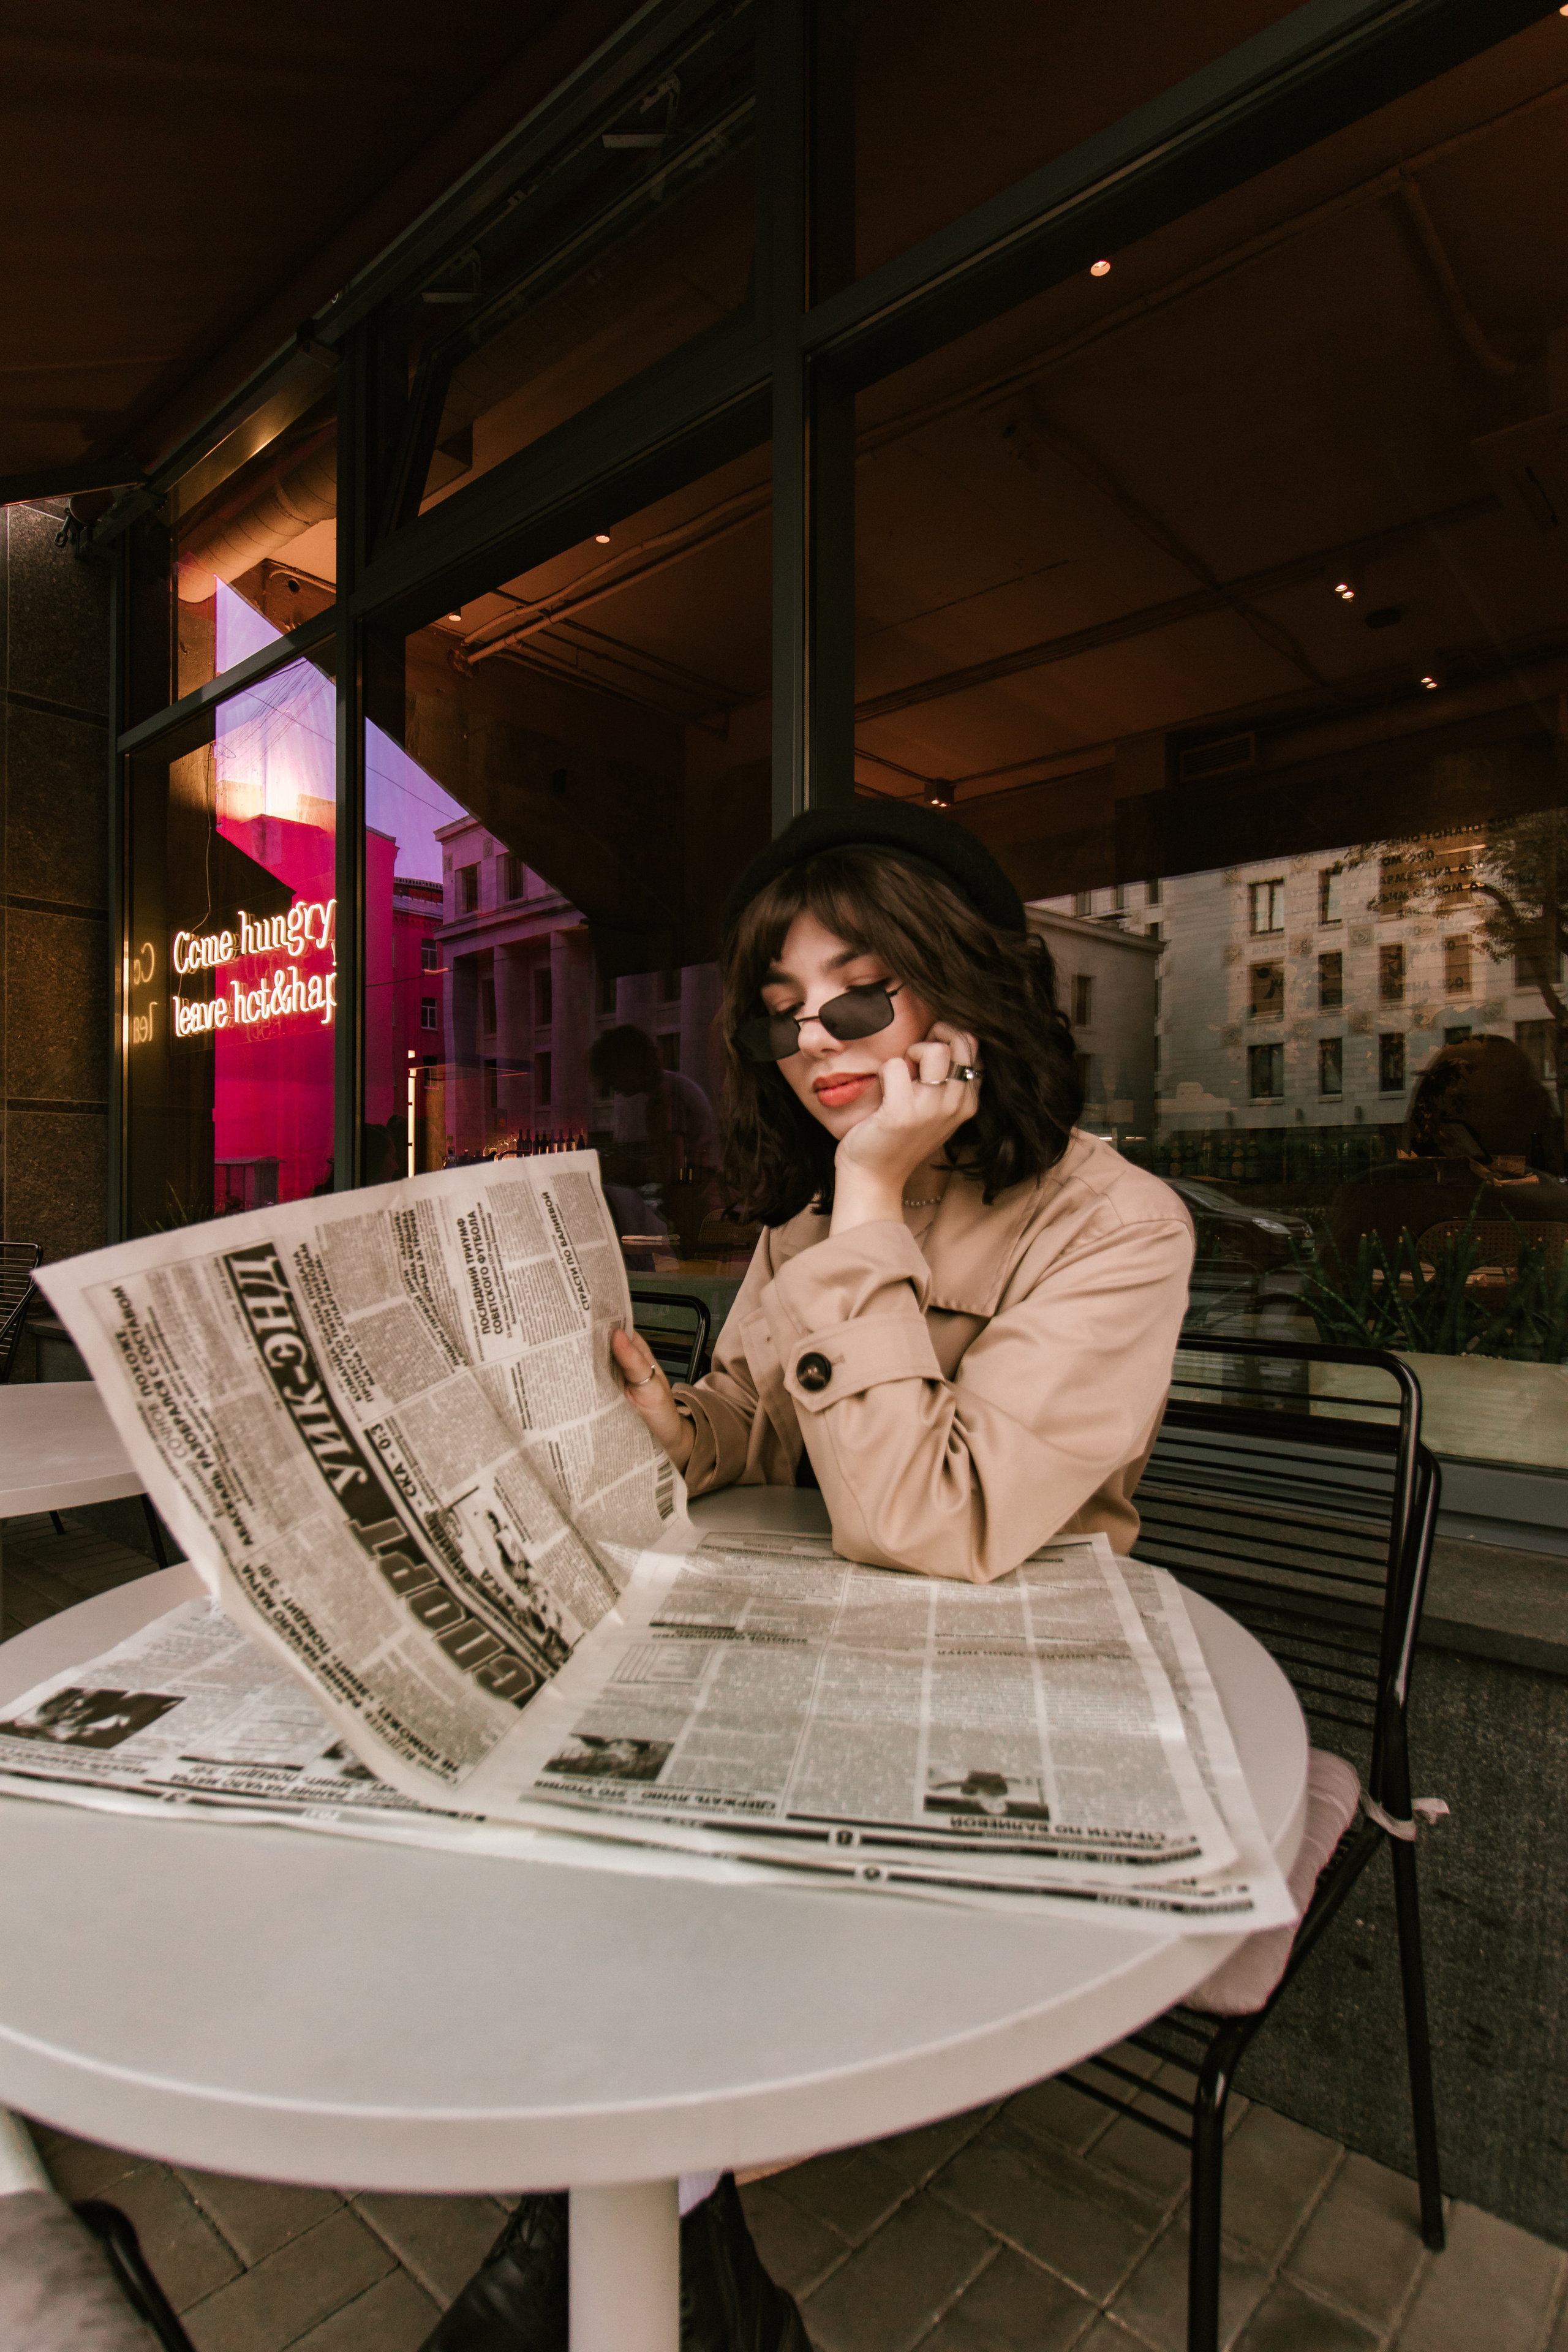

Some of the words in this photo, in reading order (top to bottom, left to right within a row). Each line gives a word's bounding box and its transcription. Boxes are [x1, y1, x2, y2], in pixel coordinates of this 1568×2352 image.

[173, 930, 233, 974] Come
[238, 899, 336, 956] hungry
[173, 995, 228, 1036] leave
[405, 1208, 420, 1250] ТРОФЕЙ
[454, 1216, 474, 1265] ТРИУМФ
[466, 1210, 487, 1265] ФУТБОЛА
[539, 1189, 568, 1248] ВАЛИЕВОЙ
[290, 1250, 316, 1300] ПОДАЛА
[298, 1241, 328, 1306] ЭПИЗОДАМ
[414, 1248, 424, 1263] ЗА
[486, 1251, 495, 1266] СССР
[562, 1248, 575, 1266] ПО
[417, 1262, 435, 1303] БОРЬБЫ
[464, 1264, 491, 1336] ПОСЛЕДНИЙ
[478, 1264, 503, 1336] СОВЕТСКОГО
[569, 1265, 591, 1311] СТРАСТИ
[109, 1283, 155, 1366] СОСТАВОМ
[311, 1300, 333, 1345] ЮРАНА
[321, 1307, 339, 1338] ПЯТИ
[412, 1294, 439, 1330] ПЕРВОЙ
[333, 1338, 349, 1357] ПО
[342, 1333, 356, 1350] СО
[435, 1329, 461, 1368] ЛИДЕРЫ
[145, 1364, 161, 1379] С
[230, 1254, 368, 1495] УИК-ЭНД
[328, 1346, 363, 1403] КОМАНДА
[344, 1356, 375, 1403] ПРОТЕСТ
[351, 1349, 376, 1387] МАТЧА
[151, 1378, 214, 1471] РАЗОБРАЛСЯ
[369, 1422, 393, 1452] 0:3
[390, 1461, 419, 1499] СКА
[207, 1468, 254, 1548] АБАСКАЛЬ
[239, 1563, 277, 1611] МАТЧА
[347, 1517, 535, 1698] СПОРТ
[270, 1608, 321, 1664] НАЧАЛО
[279, 1596, 332, 1656] ПОБЕДИТ
[317, 1662, 363, 1711] РАННЕЕ
